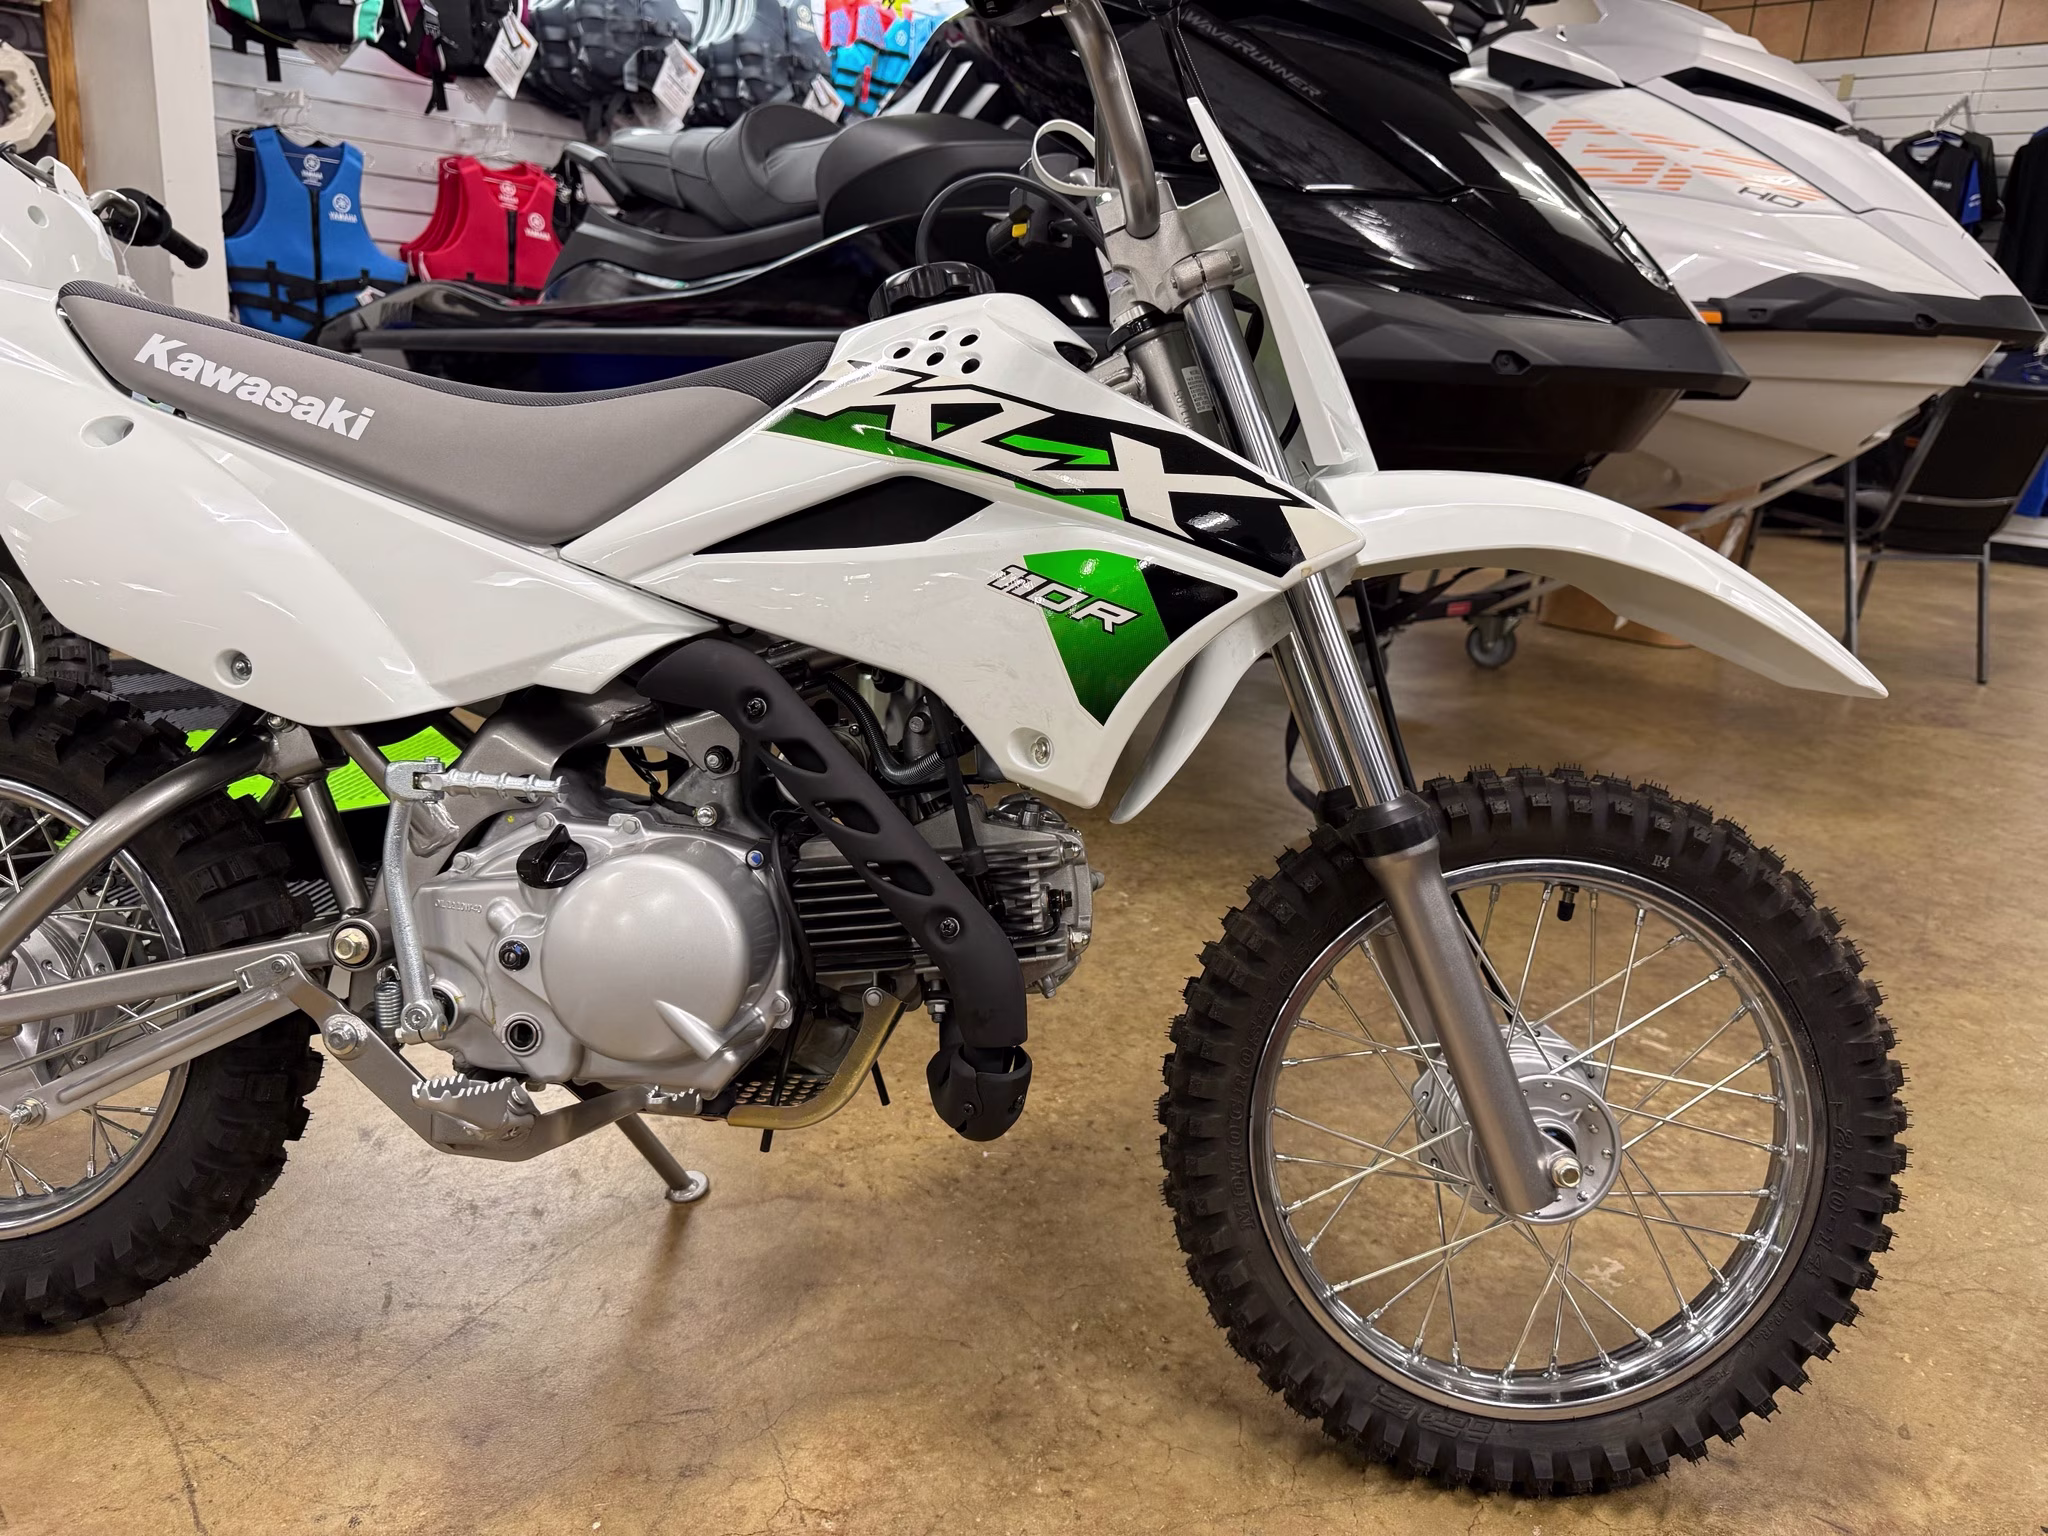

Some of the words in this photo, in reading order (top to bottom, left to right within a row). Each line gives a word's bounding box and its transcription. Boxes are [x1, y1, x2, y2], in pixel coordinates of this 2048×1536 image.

[1185, 9, 1322, 97] WAVERUNNER
[328, 211, 358, 223] YAMAHA
[1738, 186, 1804, 208] HO
[134, 333, 376, 440] Kawasaki
[803, 361, 1293, 541] KLX
[986, 564, 1143, 635] 110R
[1227, 1000, 1276, 1230] MOTOCROSS
[1804, 1126, 1854, 1277] 2.50-14
